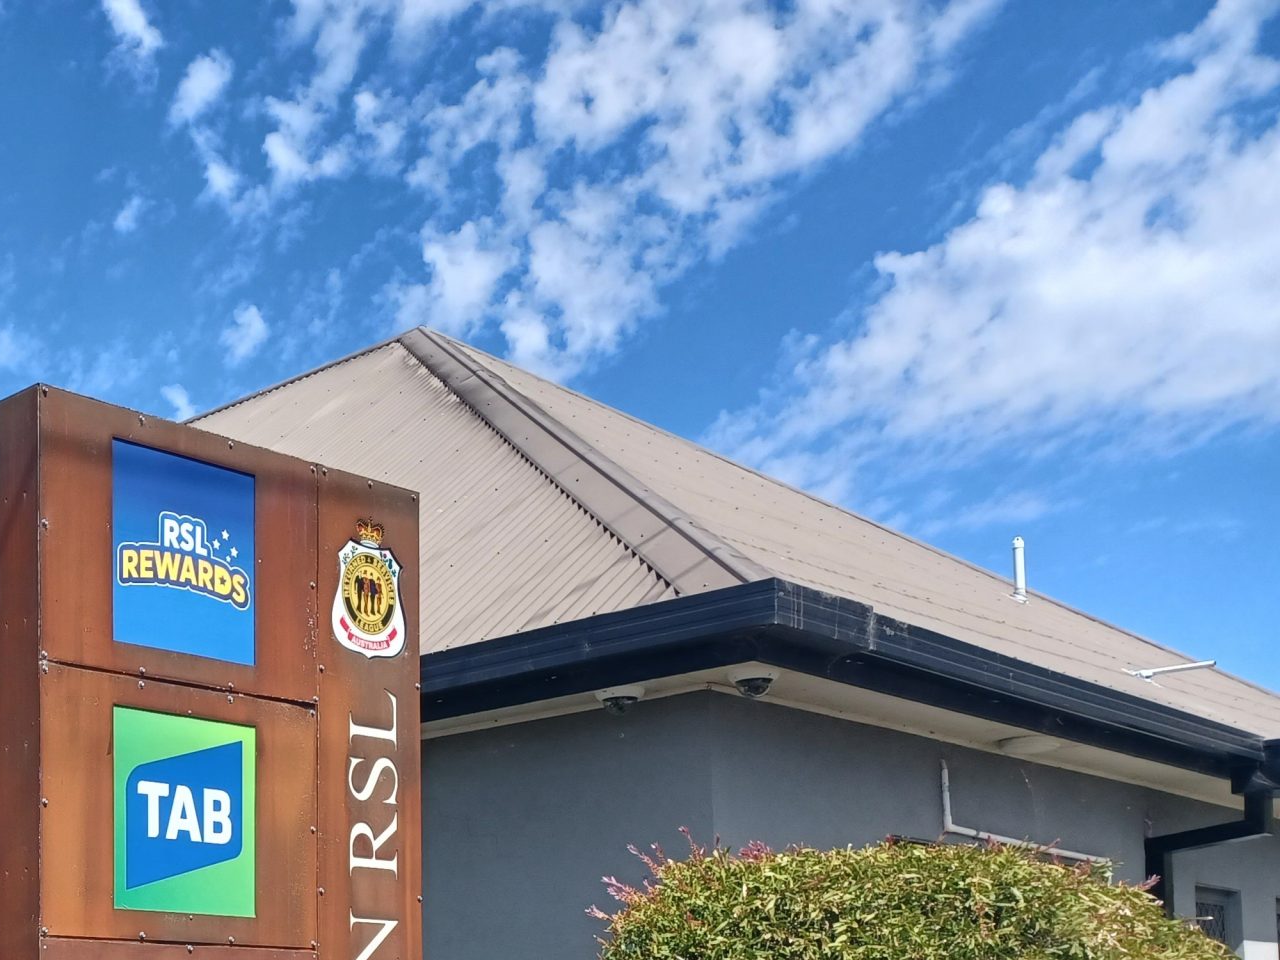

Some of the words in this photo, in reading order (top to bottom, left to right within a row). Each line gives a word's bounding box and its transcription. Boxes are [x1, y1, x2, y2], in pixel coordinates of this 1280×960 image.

[163, 519, 208, 556] RSL
[122, 549, 245, 603] REWARDS
[342, 555, 366, 598] RETURNED
[351, 636, 389, 650] AUSTRALIA
[355, 616, 384, 632] LEAGUE
[349, 693, 399, 878] RSL
[137, 780, 232, 845] TAB
